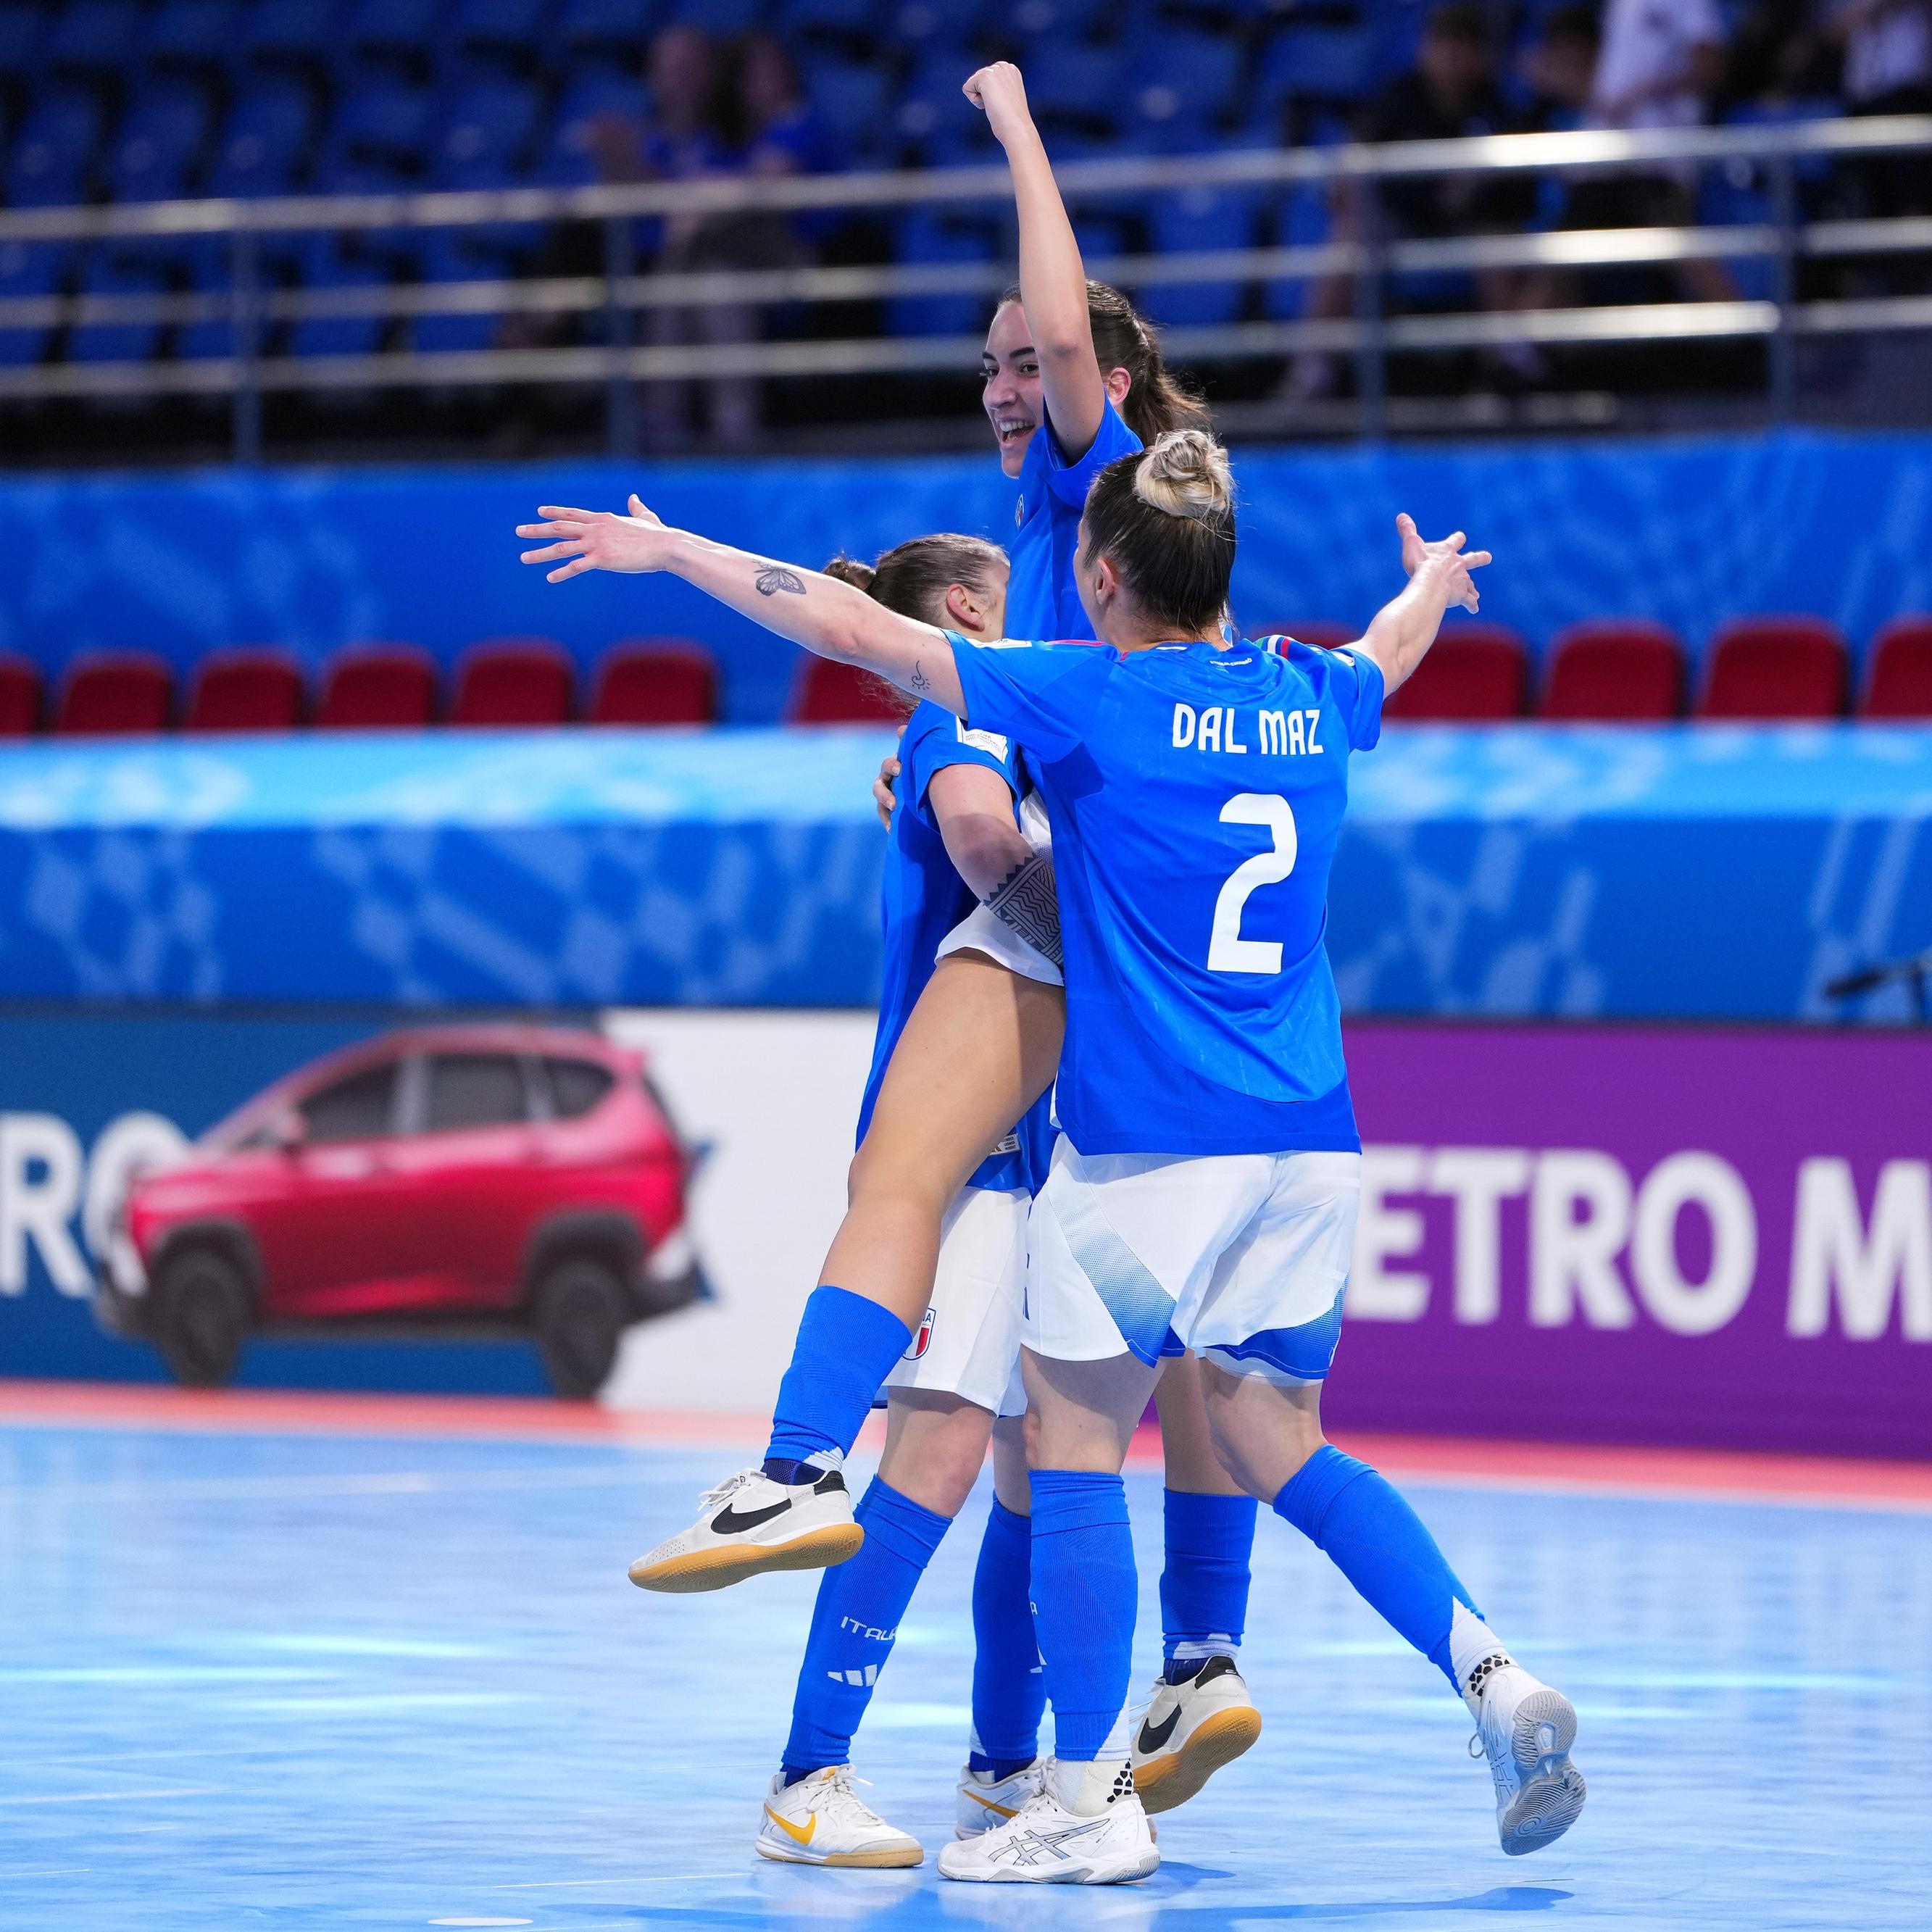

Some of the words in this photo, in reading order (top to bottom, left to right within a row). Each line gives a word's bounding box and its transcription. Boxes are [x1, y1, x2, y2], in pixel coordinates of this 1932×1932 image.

[1173, 702, 1247, 754] DAL
[1259, 709, 1324, 755] MAZ
[1207, 793, 1298, 975] 2
[1785, 1156, 1932, 1343] M
